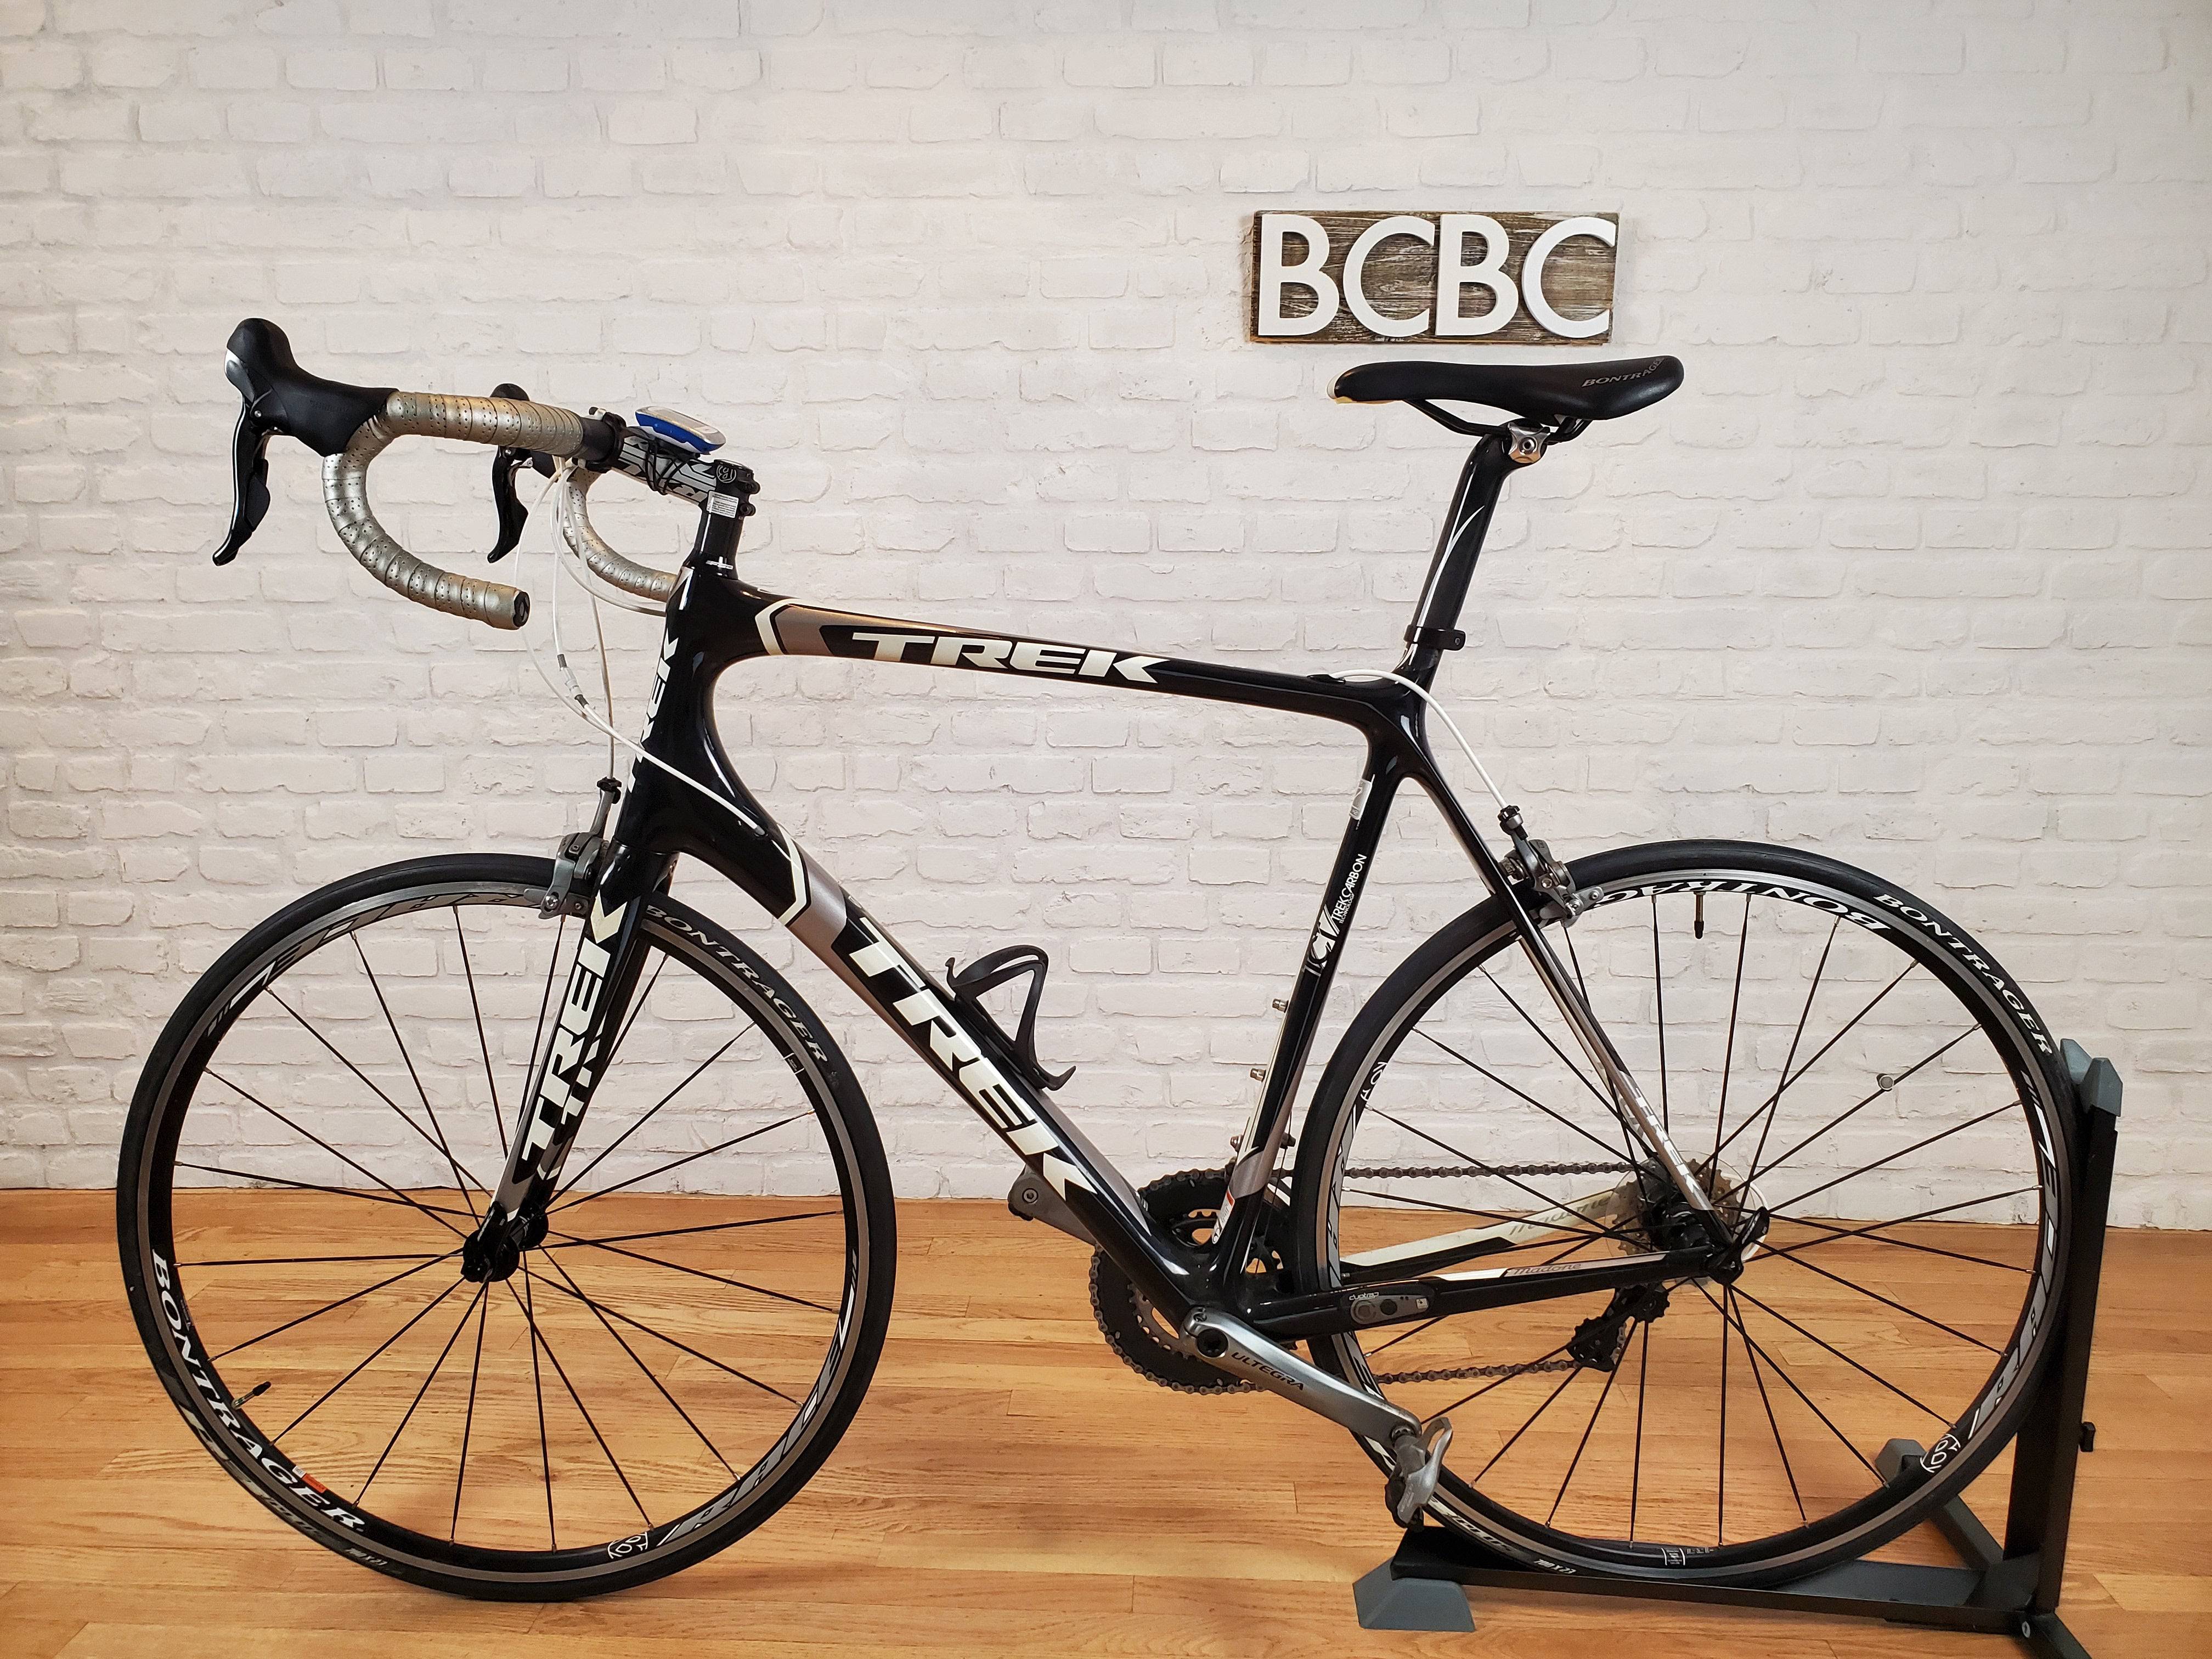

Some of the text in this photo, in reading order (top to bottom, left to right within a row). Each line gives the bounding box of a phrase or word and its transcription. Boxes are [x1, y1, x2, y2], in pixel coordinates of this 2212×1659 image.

[1258, 213, 1617, 339] BCBC
[851, 633, 1171, 684] TREK
[1330, 854, 1367, 923] TREK CARBON
[1593, 881, 1892, 930] BONTRAG
[522, 889, 628, 1160] TREK
[646, 904, 828, 1063] BONTRAGER
[1873, 893, 2052, 1053] BONTRAGER
[848, 916, 1098, 1201] TREK
[1635, 1087, 1701, 1194] TREK
[1513, 1263, 1581, 1276] Madone
[151, 1248, 366, 1529] BONTRAGER
[1231, 1351, 1304, 1391] ULTEGRA
